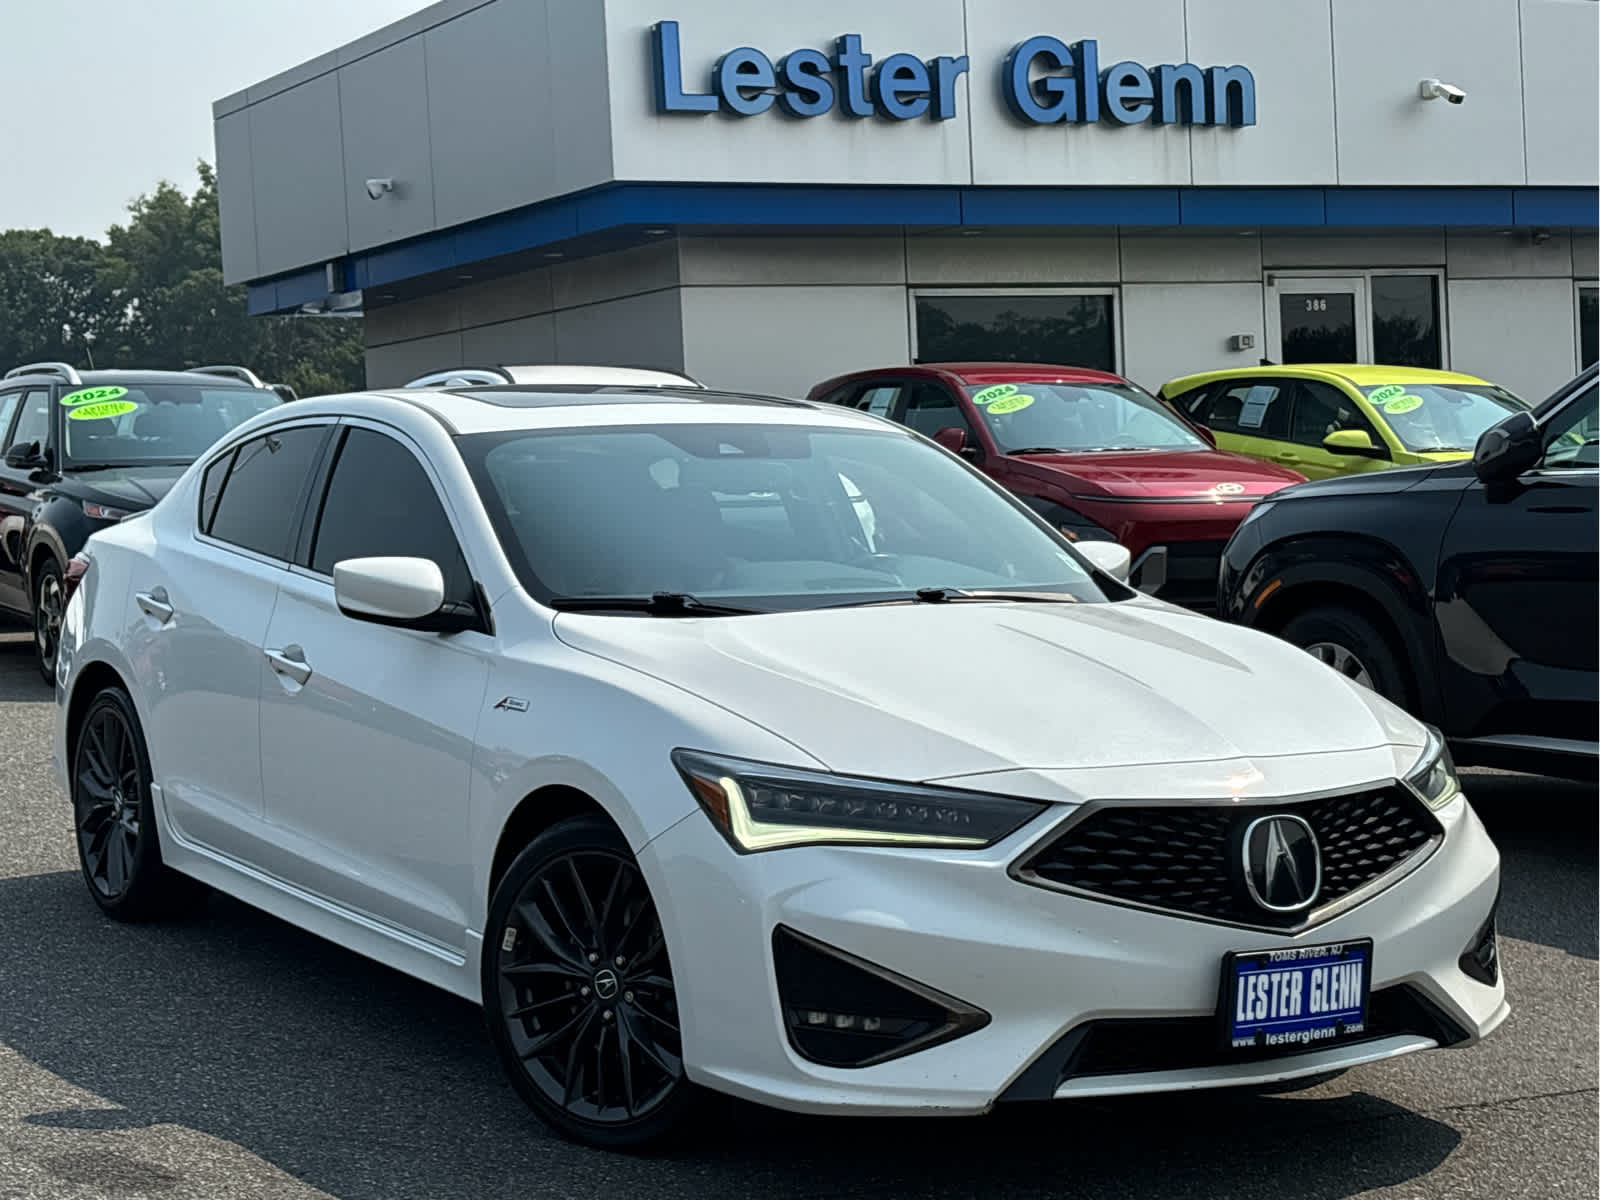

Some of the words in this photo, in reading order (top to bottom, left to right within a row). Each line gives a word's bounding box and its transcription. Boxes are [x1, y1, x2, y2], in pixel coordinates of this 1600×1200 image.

[650, 20, 969, 122] Lester
[1003, 35, 1257, 128] Glenn
[1305, 299, 1327, 311] 386
[70, 388, 120, 403] 2024
[978, 386, 1014, 402] 2024
[1372, 386, 1402, 402] 2024
[1270, 950, 1297, 962] TOMS
[1236, 970, 1303, 1022] LESTER
[1309, 962, 1363, 1014] GLENN
[1266, 1026, 1336, 1045] lesterglenn
